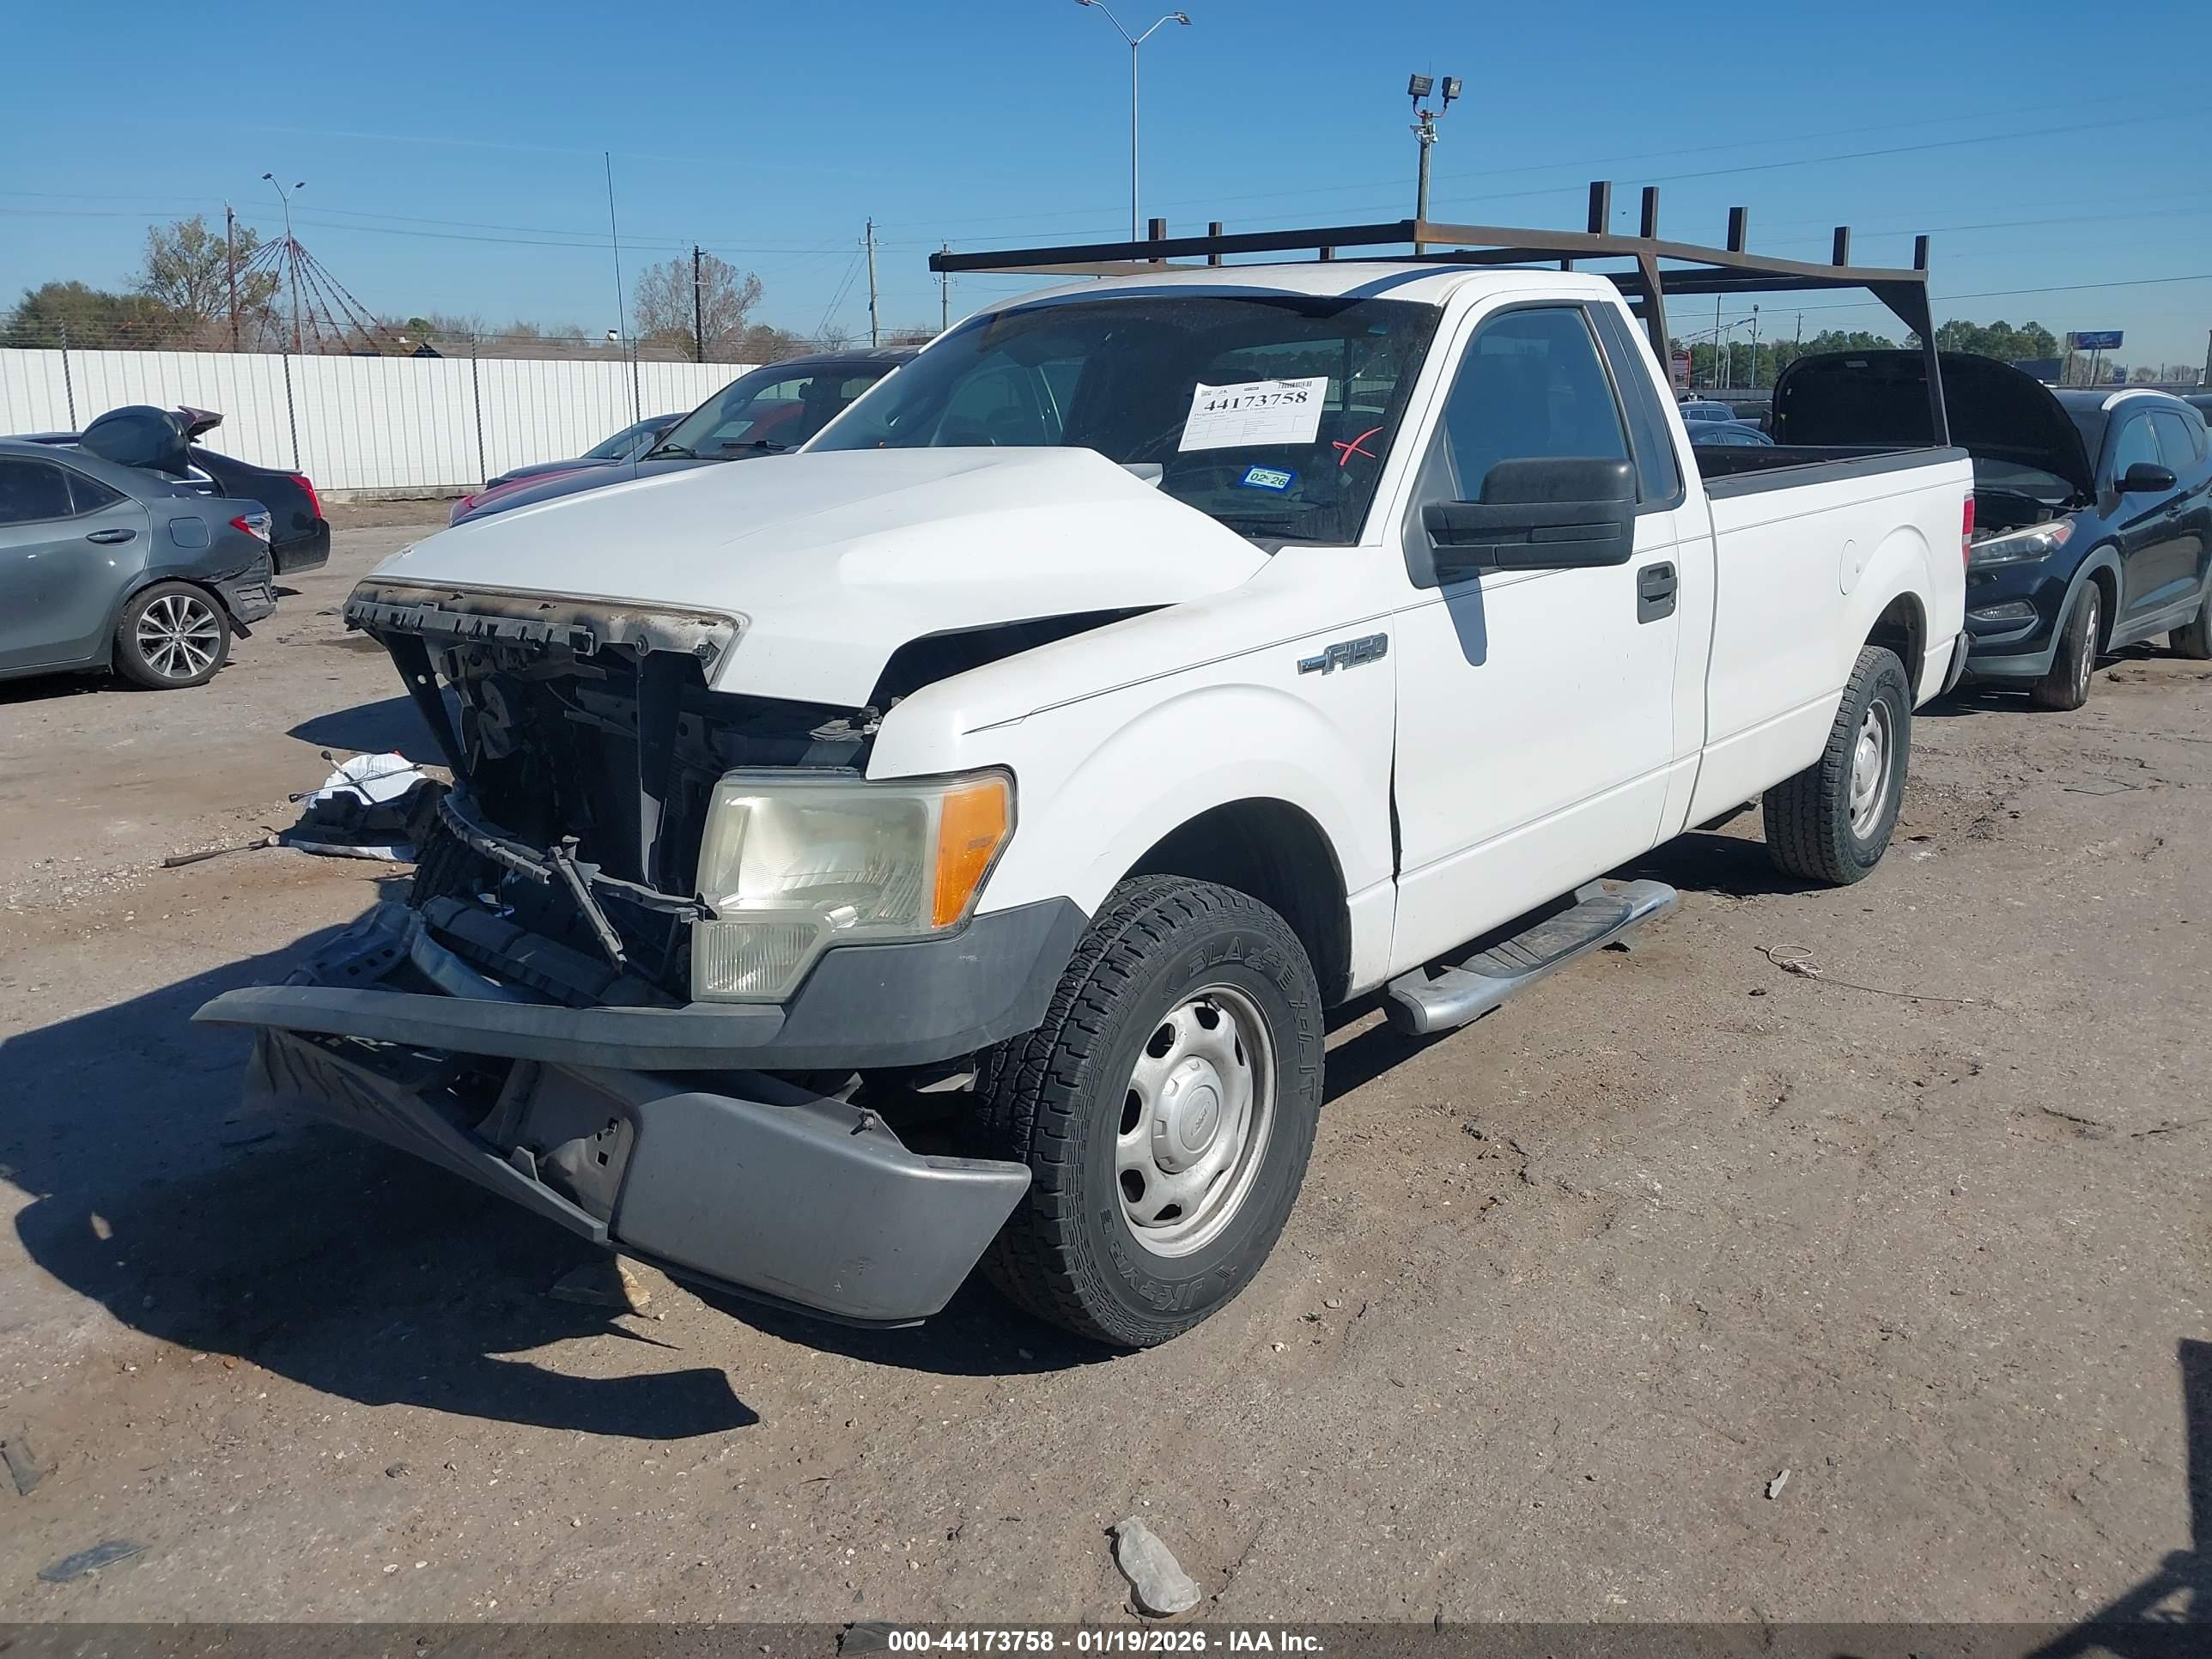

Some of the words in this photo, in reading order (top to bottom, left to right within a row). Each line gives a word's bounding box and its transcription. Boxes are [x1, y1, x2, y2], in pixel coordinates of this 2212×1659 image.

[1204, 391, 1308, 410] 44173758
[1250, 472, 1264, 482] 02
[1270, 476, 1287, 485] 26
